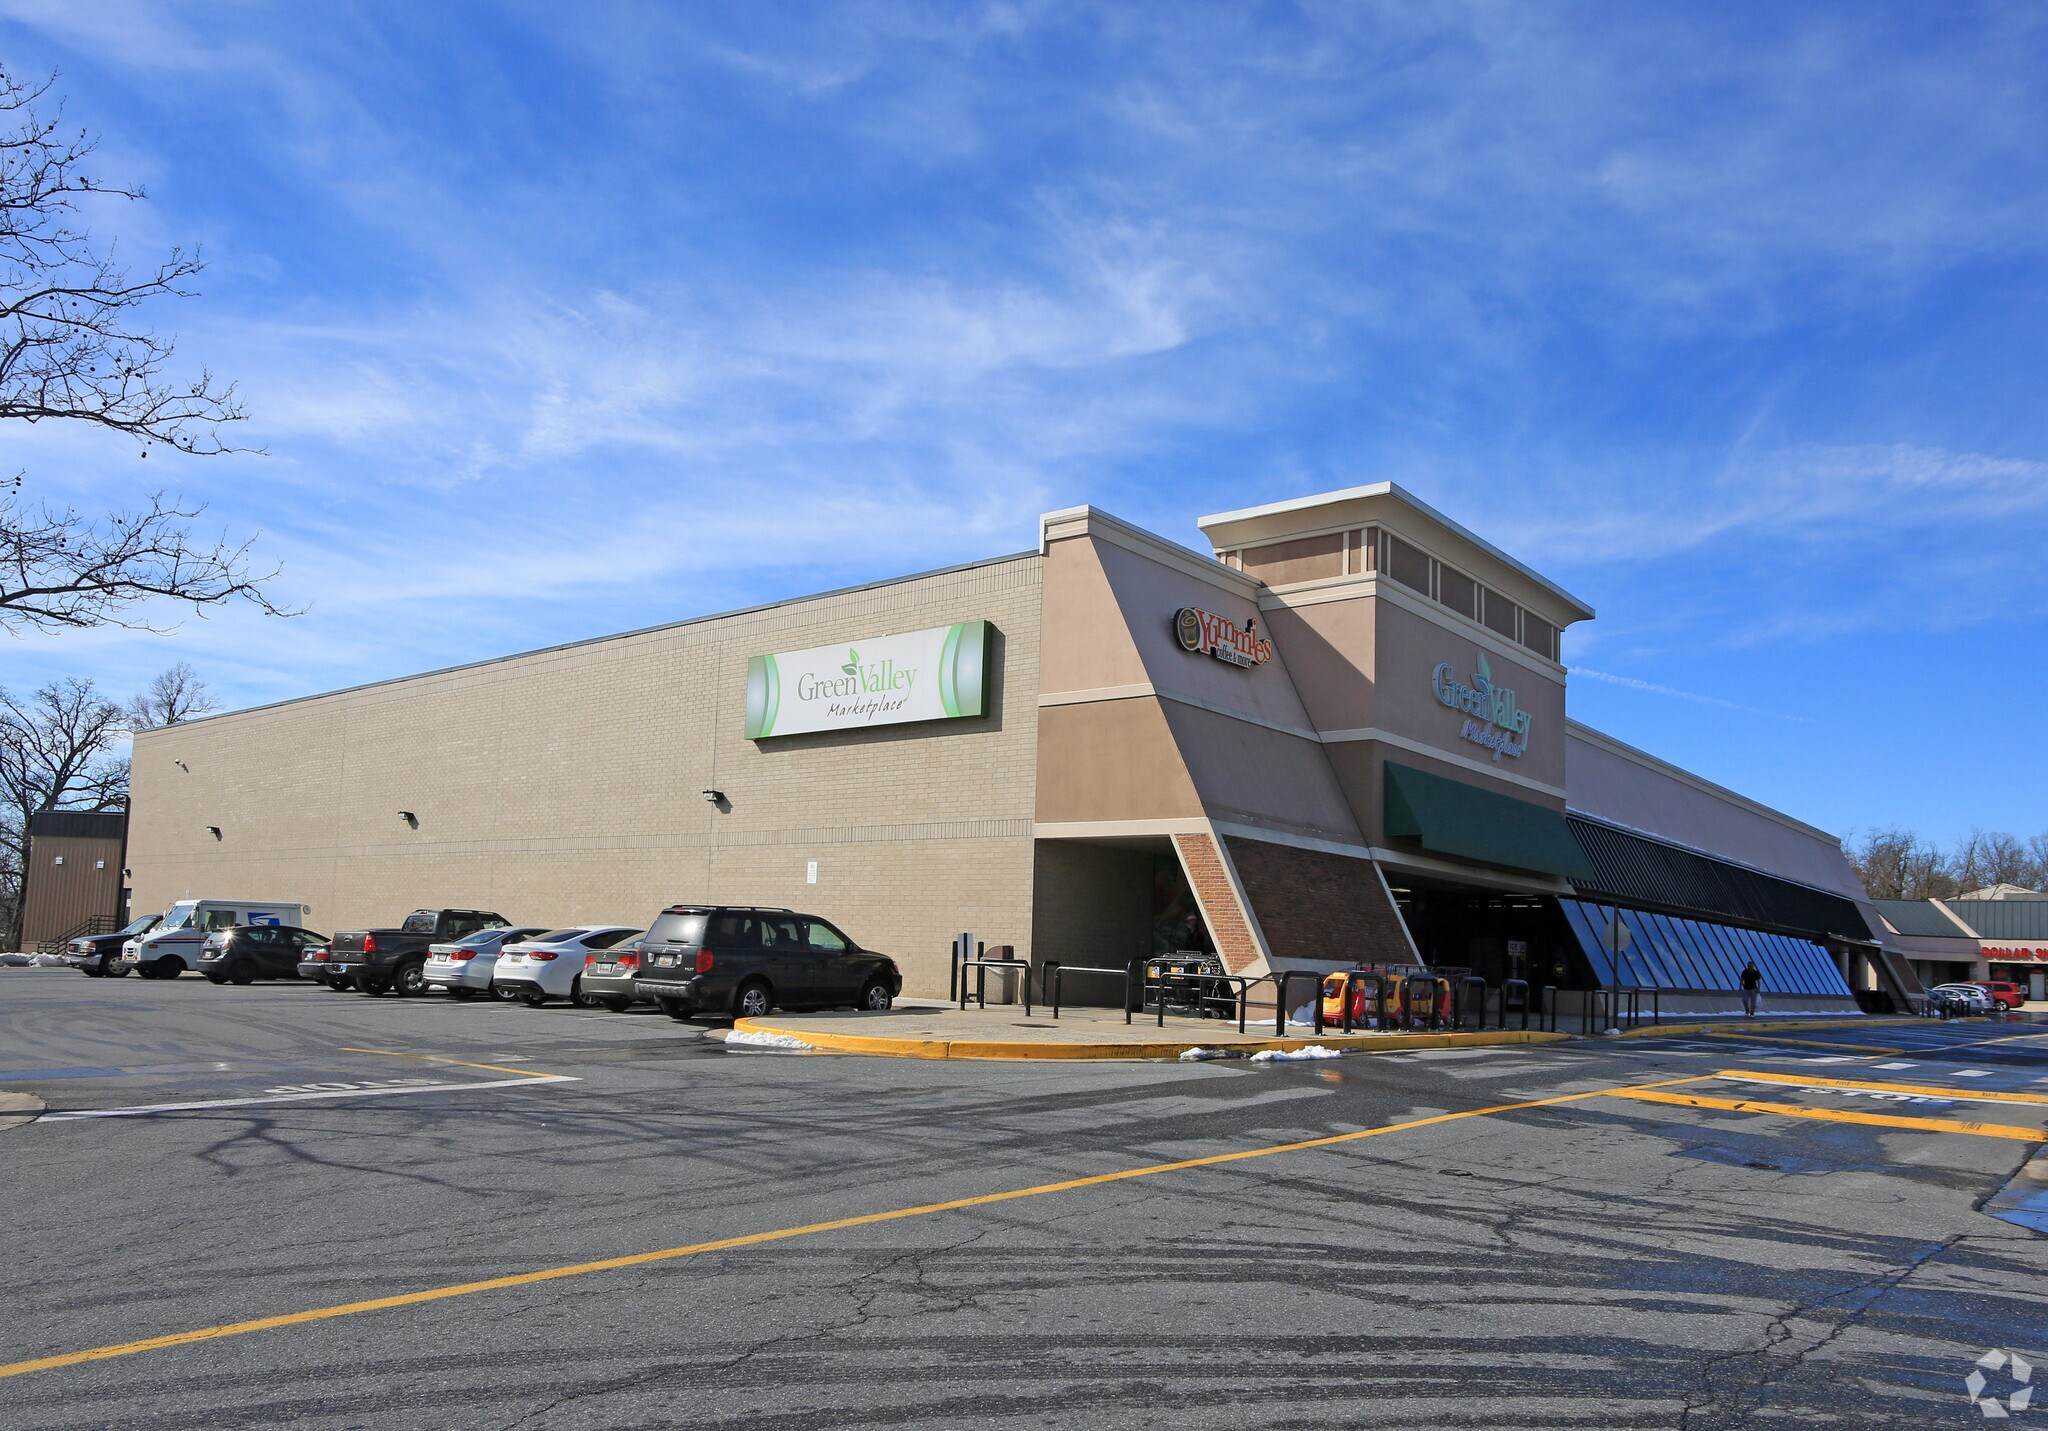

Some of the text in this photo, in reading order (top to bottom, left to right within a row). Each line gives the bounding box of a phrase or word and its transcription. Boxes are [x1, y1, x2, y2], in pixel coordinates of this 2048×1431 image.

[1195, 609, 1271, 664] Yummies
[1216, 644, 1232, 661] coffee
[827, 695, 903, 721] Marketplace
[1982, 946, 2031, 958] DOLLAR
[263, 1078, 443, 1094] STOP
[1799, 1088, 1954, 1103] STOP
